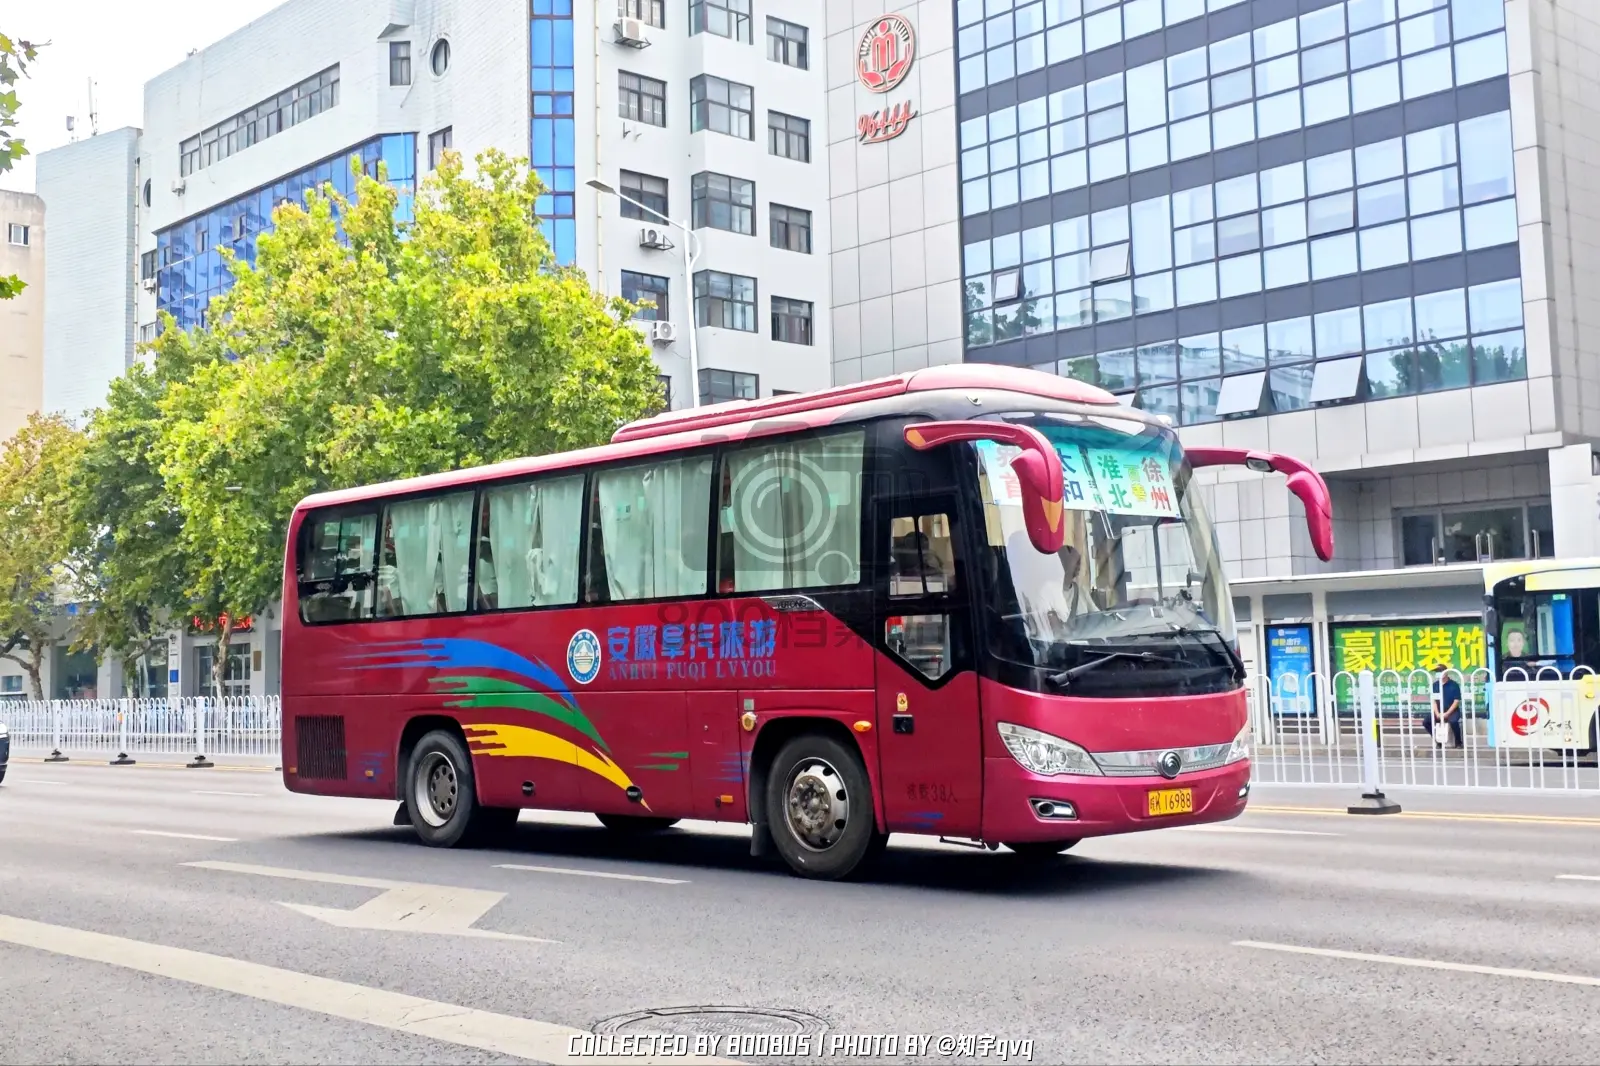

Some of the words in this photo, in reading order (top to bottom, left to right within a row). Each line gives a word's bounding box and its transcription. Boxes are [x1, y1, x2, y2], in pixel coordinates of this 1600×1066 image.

[1097, 454, 1132, 508] 淮北
[1141, 456, 1172, 511] 徐州
[607, 619, 776, 662] 安徽阜汽旅游
[1341, 625, 1487, 674] 豪顺装饰
[609, 662, 657, 680] ANHUI
[667, 661, 706, 681] FUQI
[716, 659, 776, 679] LVYOU
